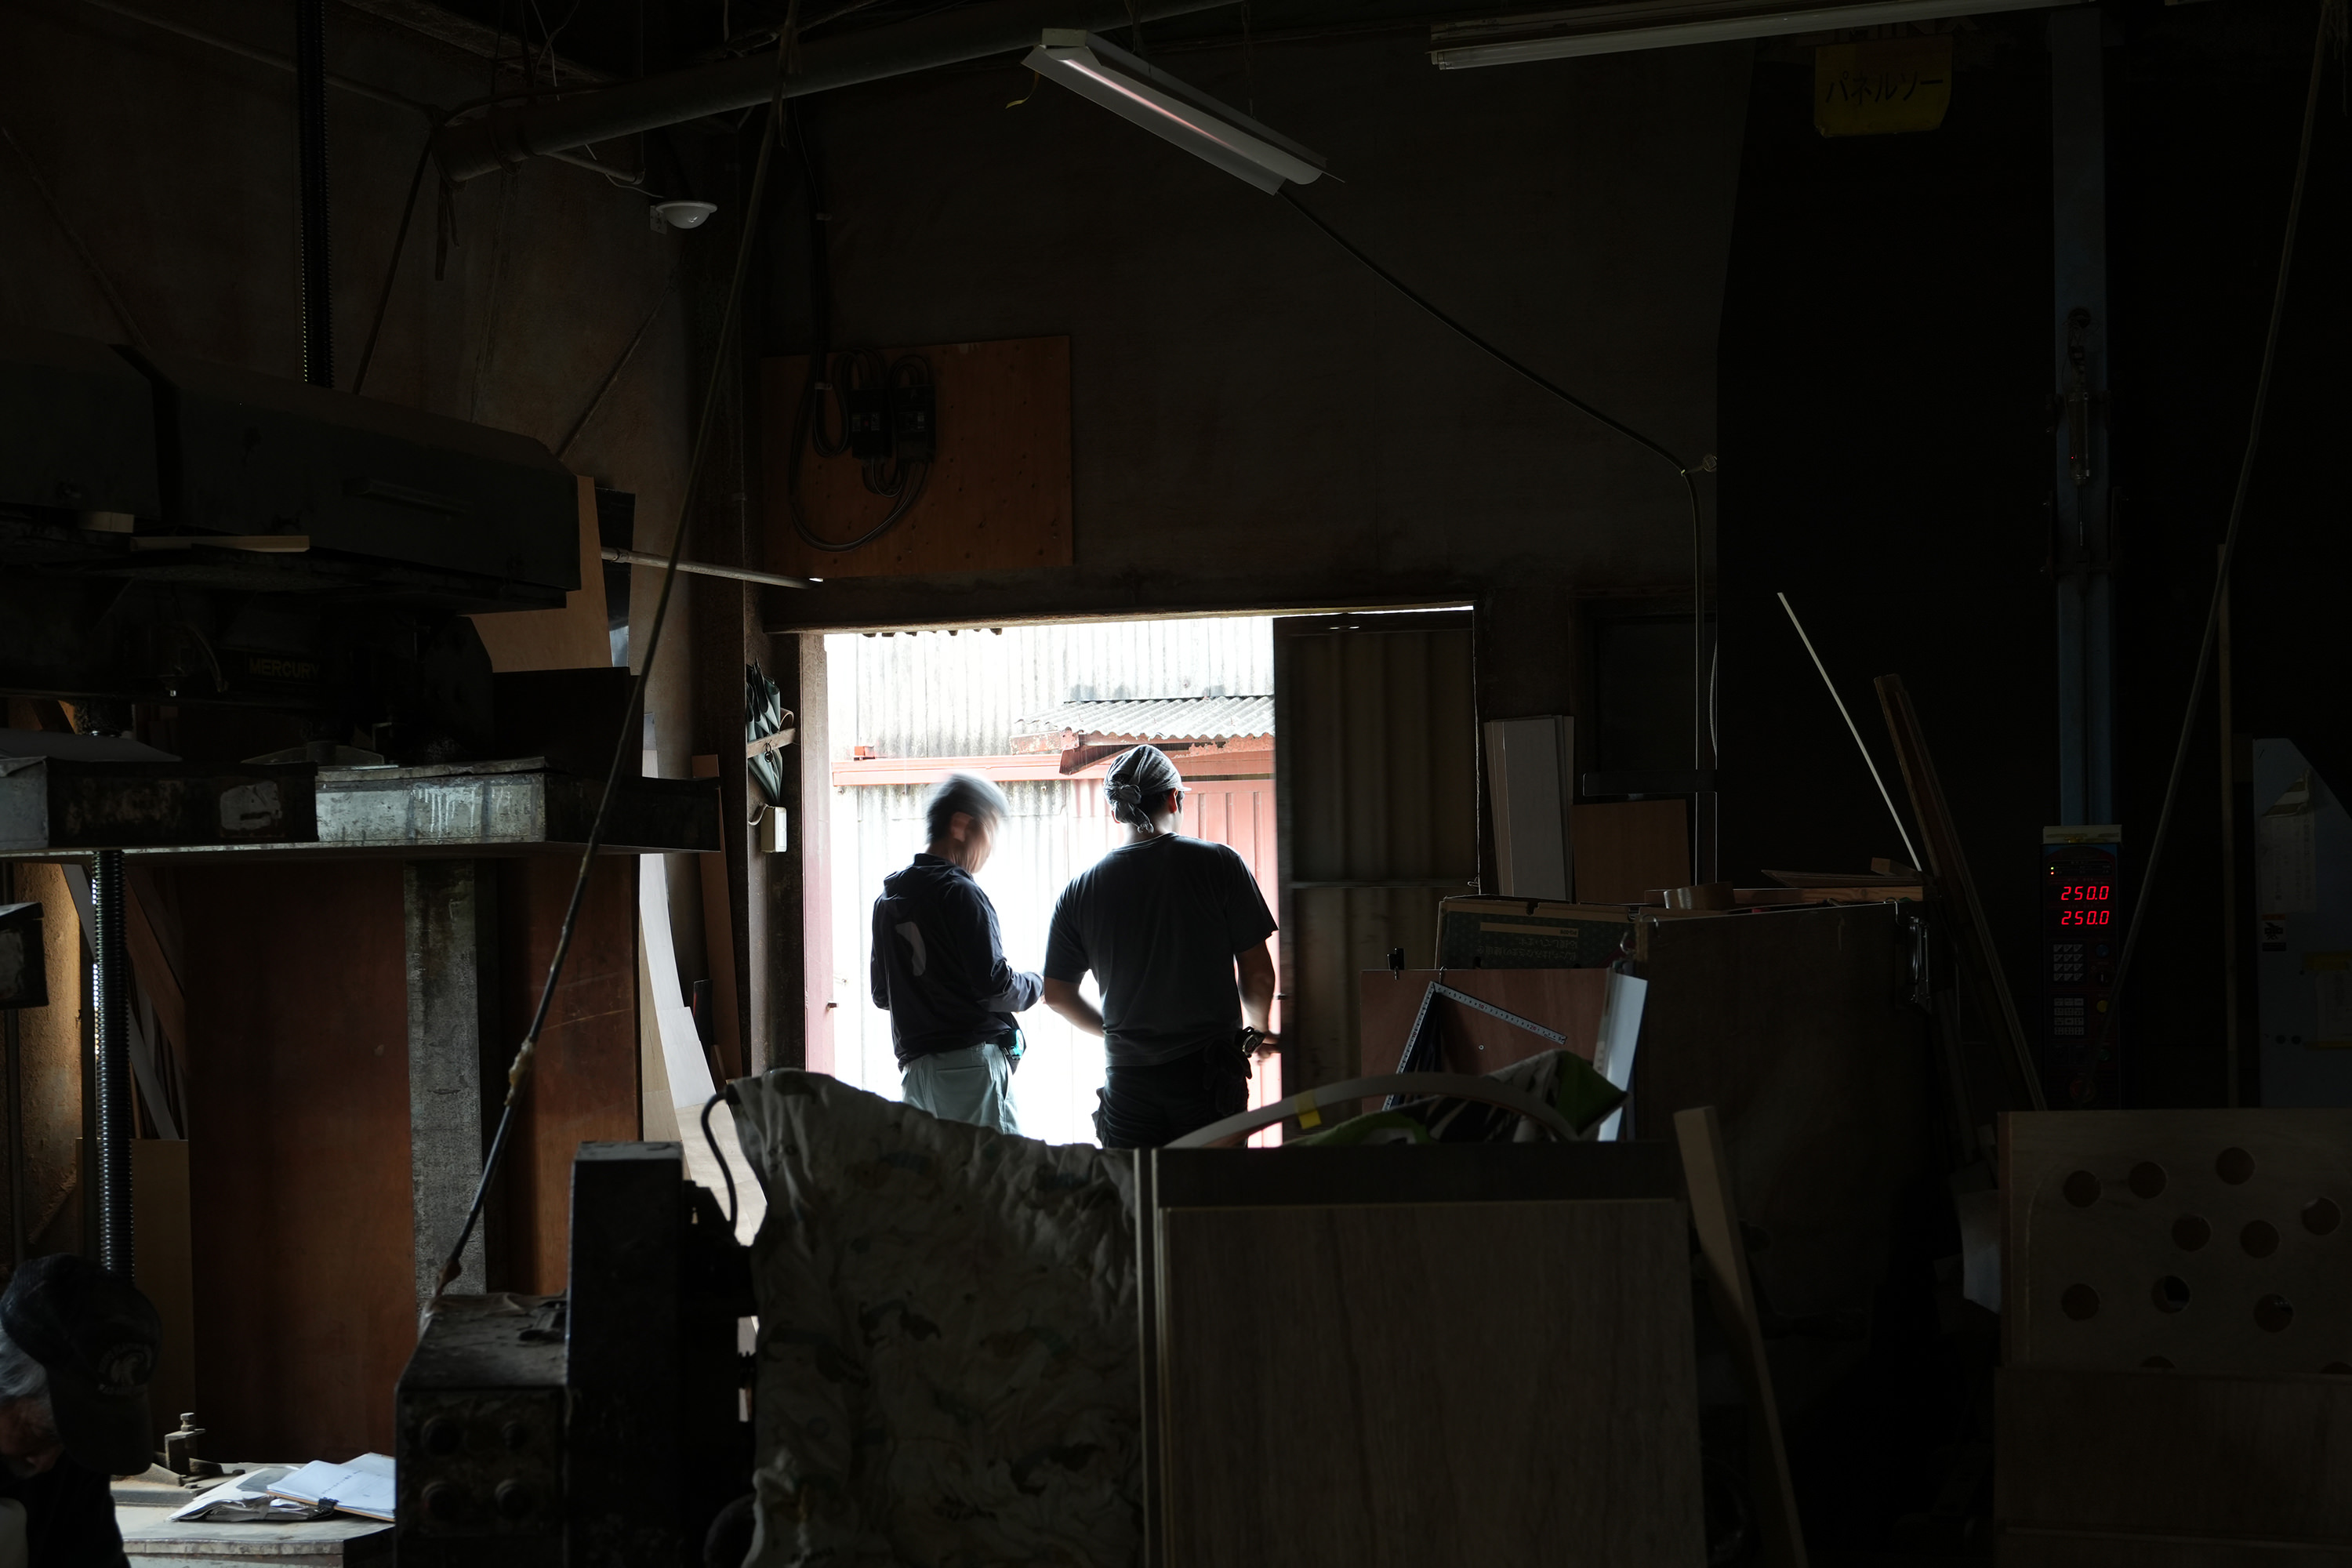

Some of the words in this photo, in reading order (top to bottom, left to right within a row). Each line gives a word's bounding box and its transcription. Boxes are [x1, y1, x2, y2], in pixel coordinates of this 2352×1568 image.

[1825, 71, 1944, 105] パネルソー
[249, 658, 321, 680] MERCURY
[2060, 885, 2111, 901] 250.0
[2060, 910, 2111, 926] 250.0
